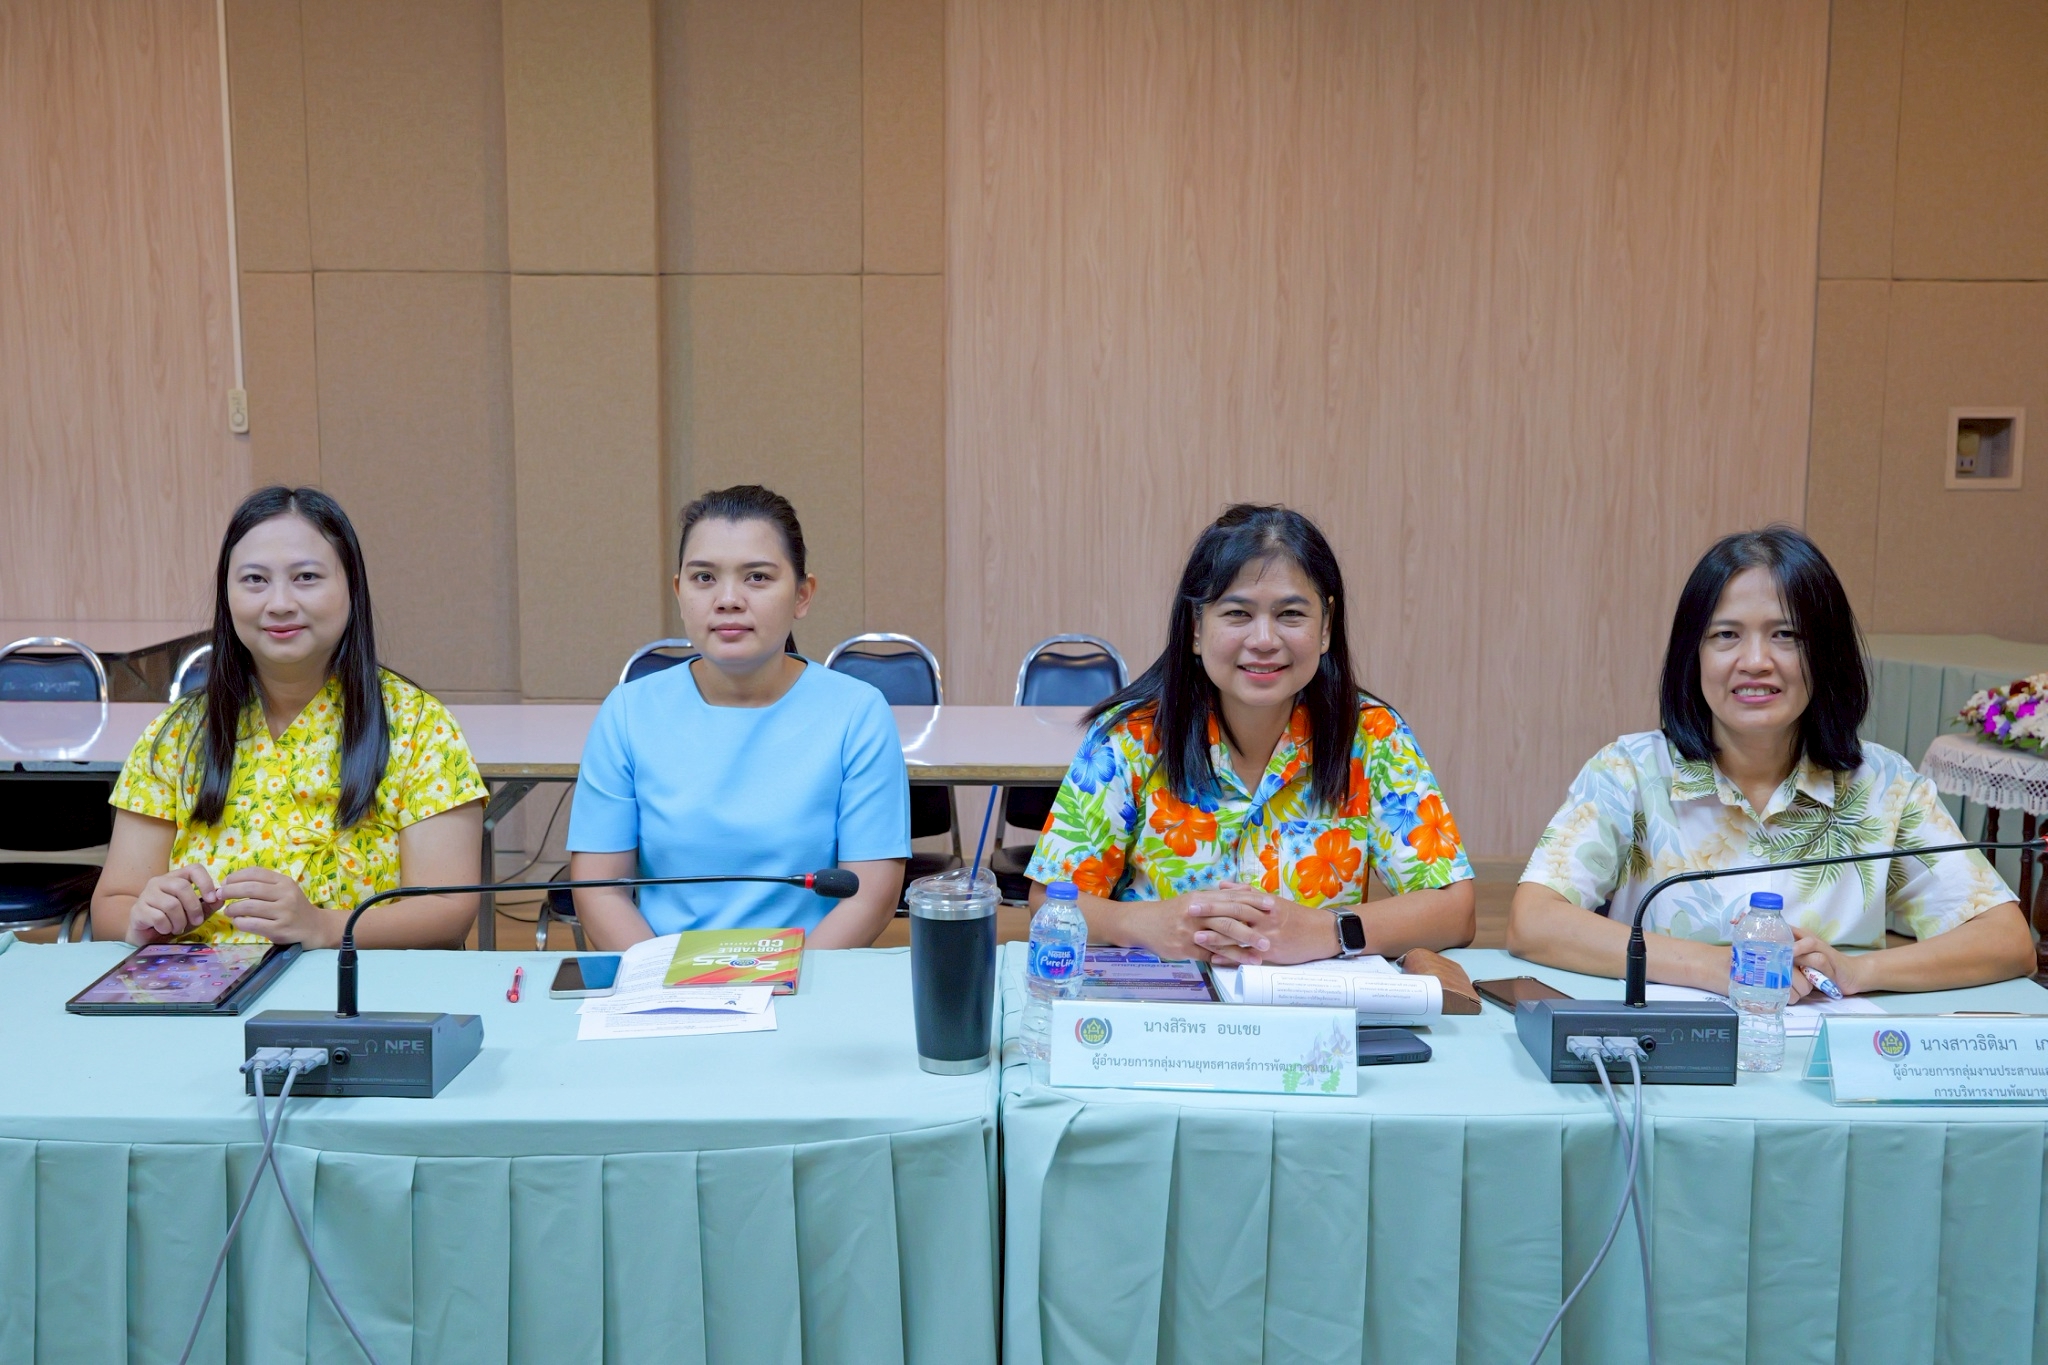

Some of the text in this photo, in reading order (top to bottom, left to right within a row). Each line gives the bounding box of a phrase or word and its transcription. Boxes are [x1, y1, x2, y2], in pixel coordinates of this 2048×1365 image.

[758, 939, 784, 947] CD
[1143, 1017, 1261, 1036] นางสิริพร อบเชย
[1691, 1028, 1730, 1039] NPE
[385, 1039, 424, 1050] NPE
[1921, 1033, 2017, 1051] นางสาวธิติมา
[1092, 1053, 1334, 1074] ผู้อำนวยการกลุ่มงานยุทธศาสตร์การพัฒนาชุมชน
